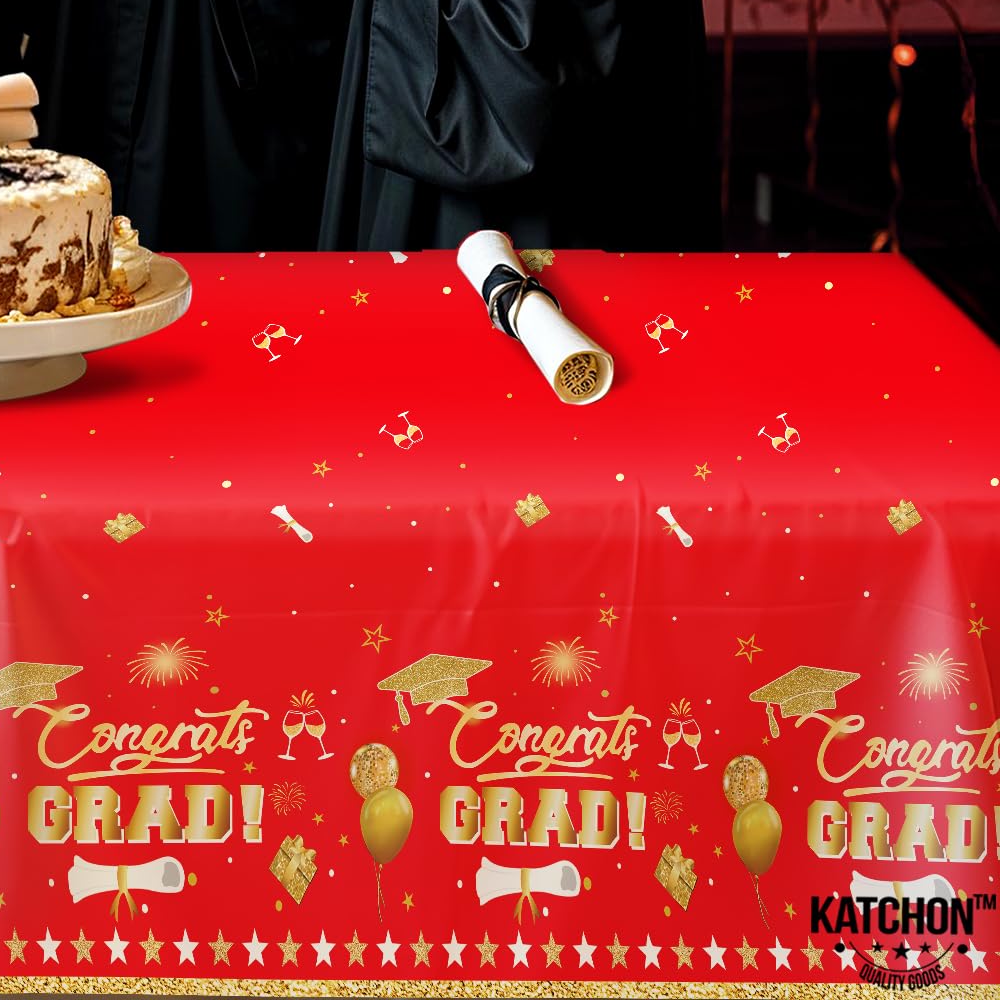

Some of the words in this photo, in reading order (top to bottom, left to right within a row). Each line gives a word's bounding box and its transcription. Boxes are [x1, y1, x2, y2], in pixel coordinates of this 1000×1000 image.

[12, 699, 270, 782] Congrats
[426, 698, 652, 783] Congrats
[27, 784, 265, 845] GRAD!
[439, 785, 648, 851] GRAD!
